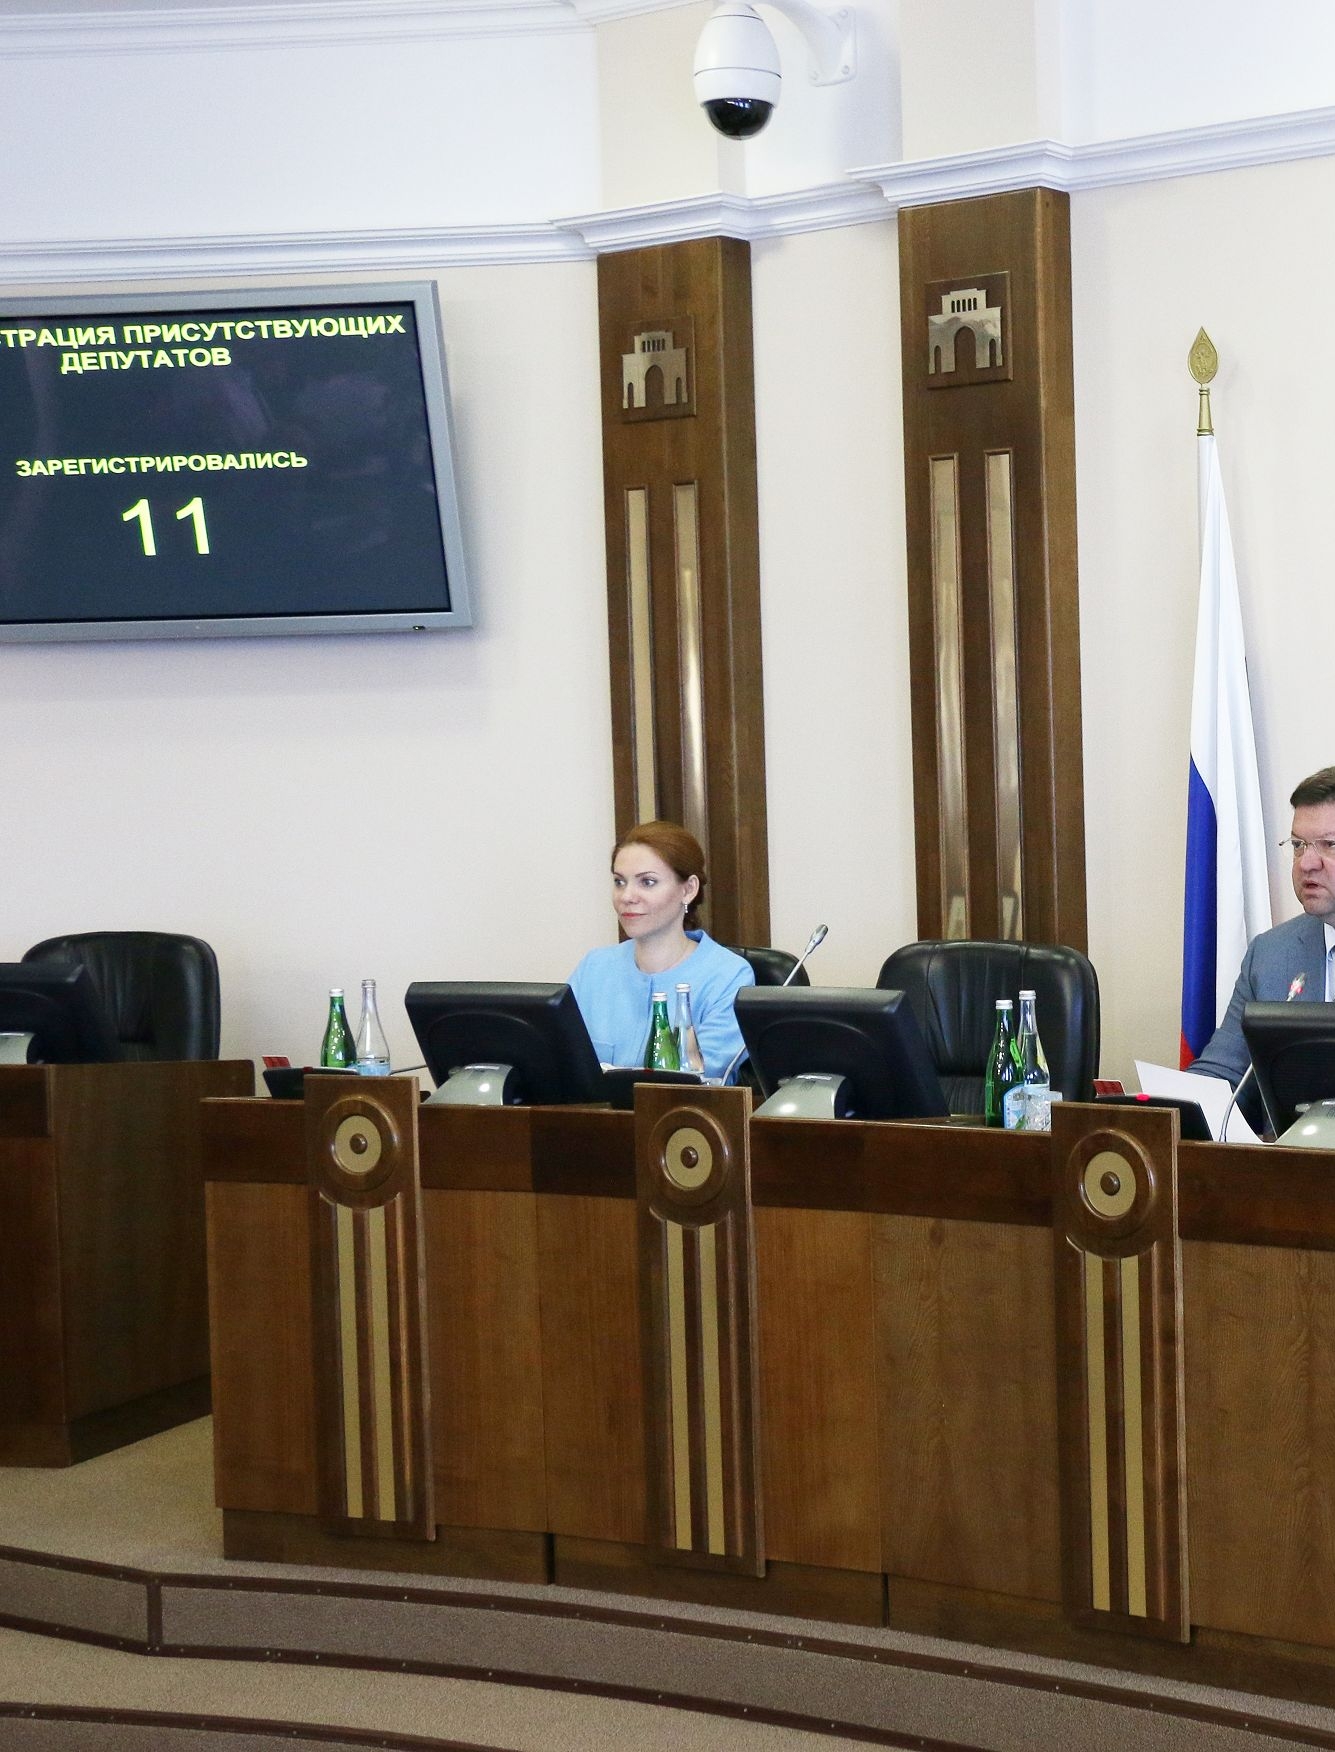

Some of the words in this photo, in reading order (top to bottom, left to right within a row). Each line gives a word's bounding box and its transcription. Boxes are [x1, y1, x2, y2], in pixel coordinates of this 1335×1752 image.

[0, 326, 116, 350] ТРАЦИЯ
[123, 315, 407, 344] ПРИСУТСТВУЮЩИХ
[60, 347, 232, 375] ДЕПУТАТОВ
[15, 451, 308, 477] ЗАРЕГИСТРИРОВАЛИСЬ
[122, 496, 210, 557] 11
